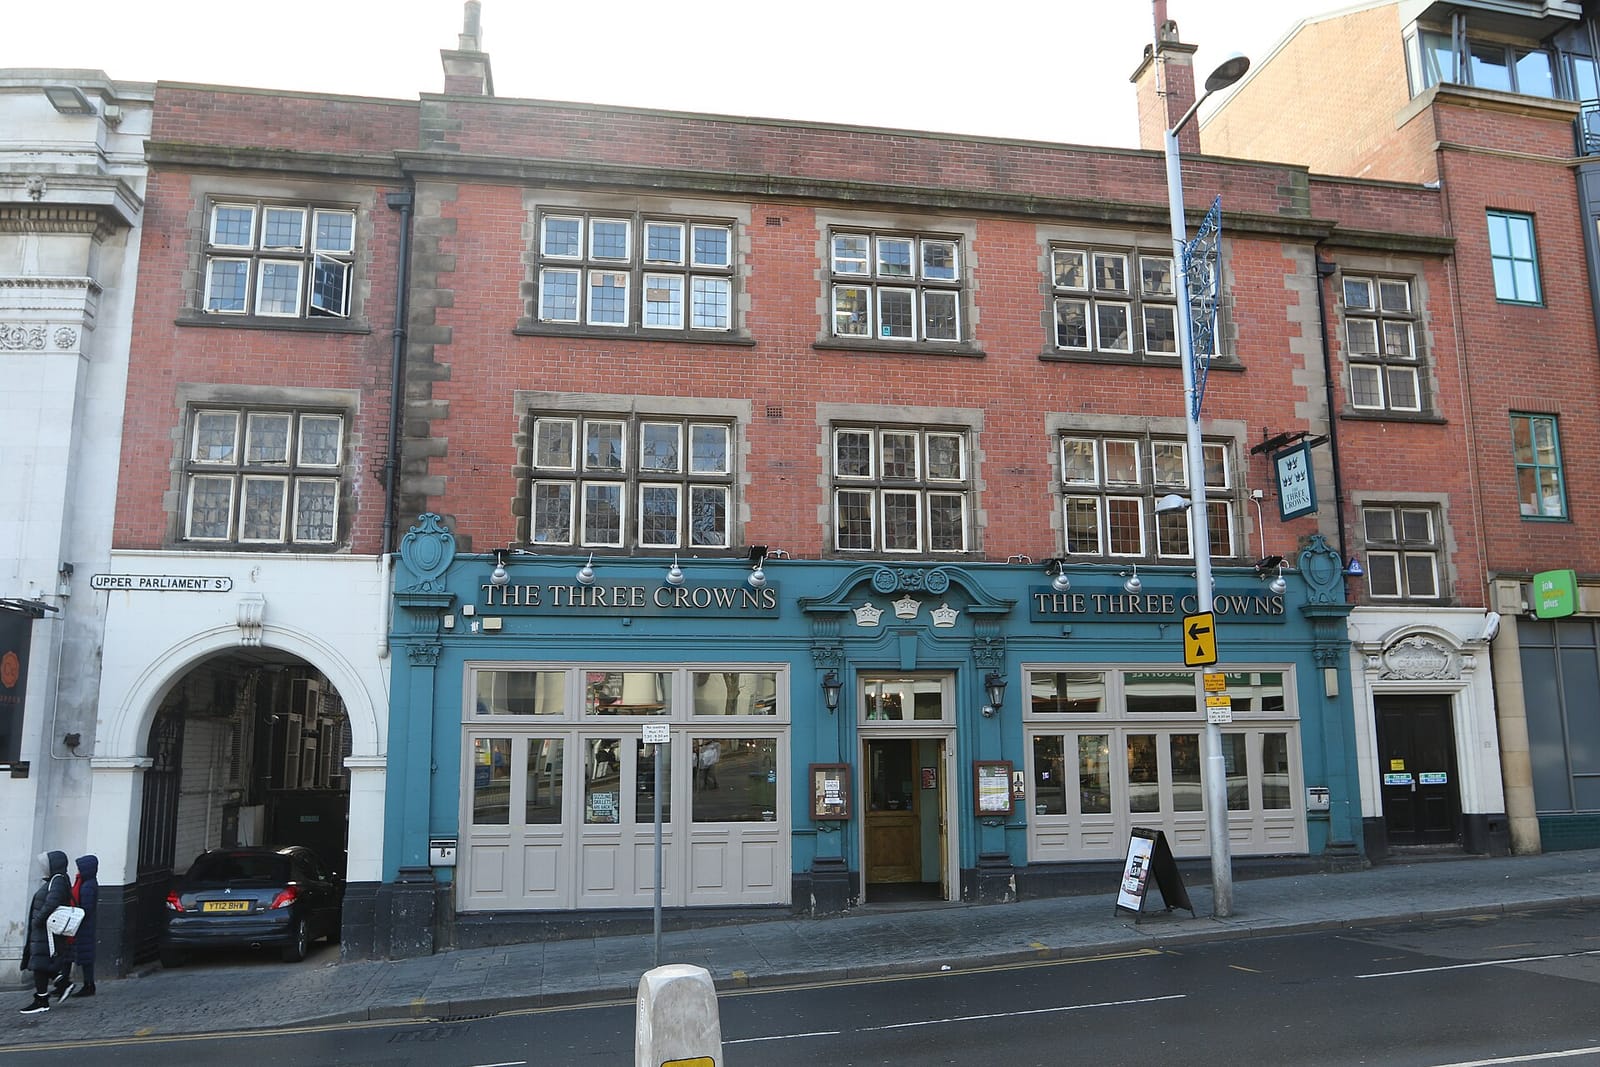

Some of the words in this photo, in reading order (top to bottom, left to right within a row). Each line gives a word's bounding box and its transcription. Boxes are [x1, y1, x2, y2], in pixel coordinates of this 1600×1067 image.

[1286, 489, 1305, 502] THREE
[1285, 497, 1309, 510] CROWNS
[96, 577, 132, 587] UPPER
[140, 578, 209, 589] PARLIAMENT
[1542, 581, 1553, 592] job
[482, 584, 541, 606] THE
[549, 585, 646, 608] THREE
[654, 586, 776, 609] CROWNS
[1034, 593, 1087, 613] THE
[1092, 594, 1176, 615] THREE
[1180, 594, 1284, 615] COWNS
[1544, 599, 1559, 610] plus
